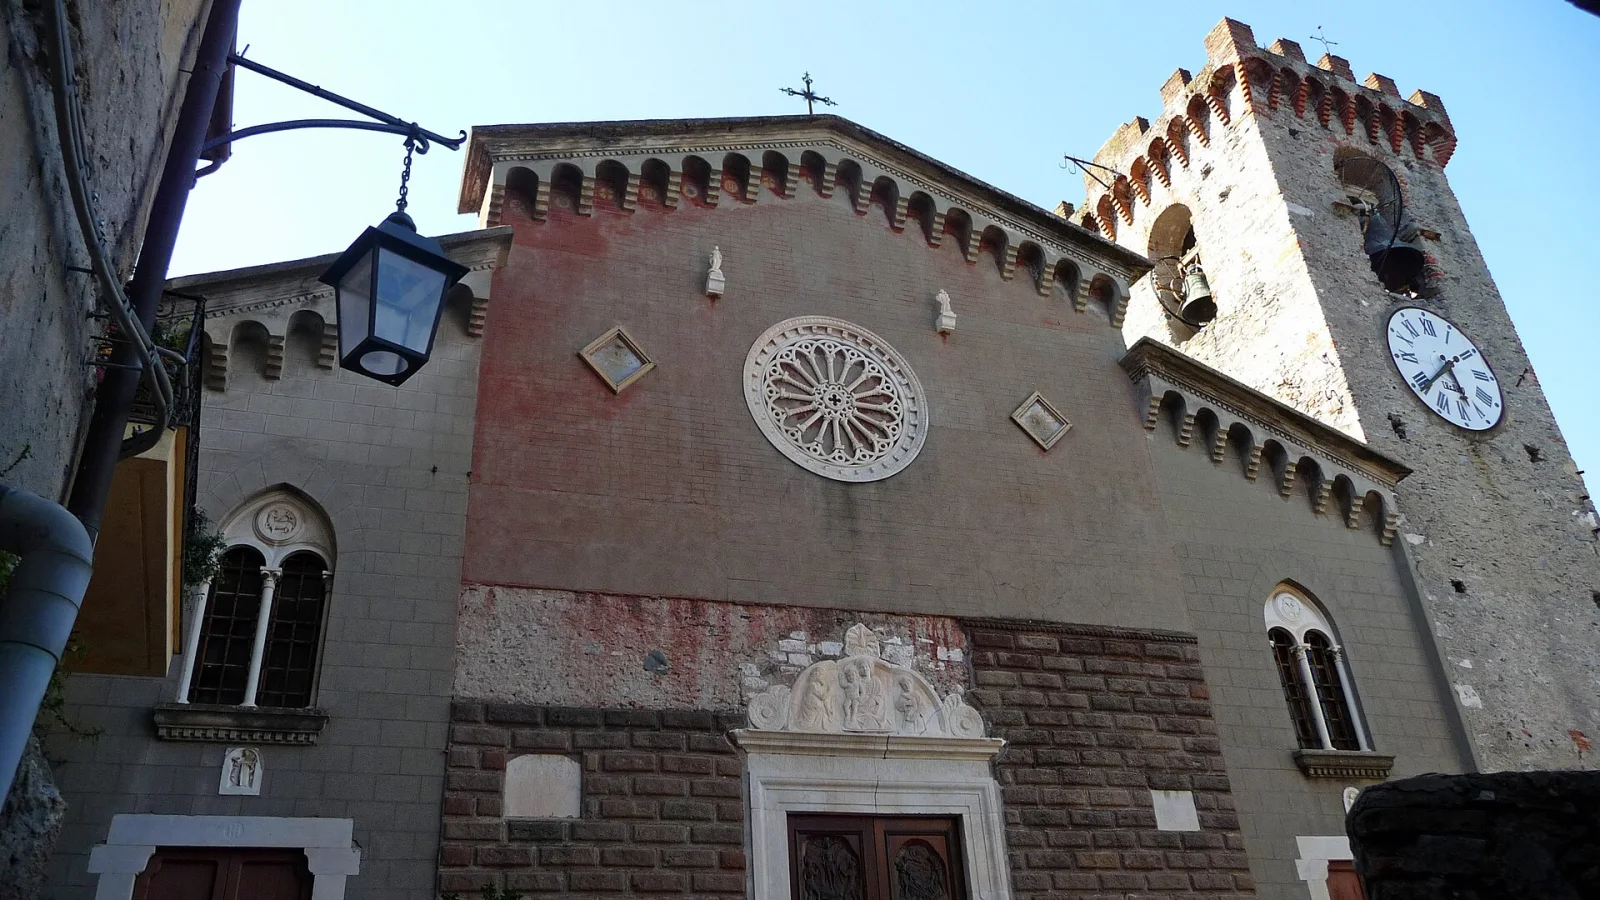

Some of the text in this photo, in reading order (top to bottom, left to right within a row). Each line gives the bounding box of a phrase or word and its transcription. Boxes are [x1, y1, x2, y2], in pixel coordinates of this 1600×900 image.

[1401, 319, 1420, 339] XI
[1419, 317, 1437, 338] XII
[1396, 331, 1414, 348] X
[1445, 330, 1450, 345] I
[1399, 349, 1419, 364] IX
[1459, 349, 1473, 361] II
[1471, 369, 1490, 382] III
[1475, 385, 1493, 408] IIII
[1472, 399, 1486, 419] V
